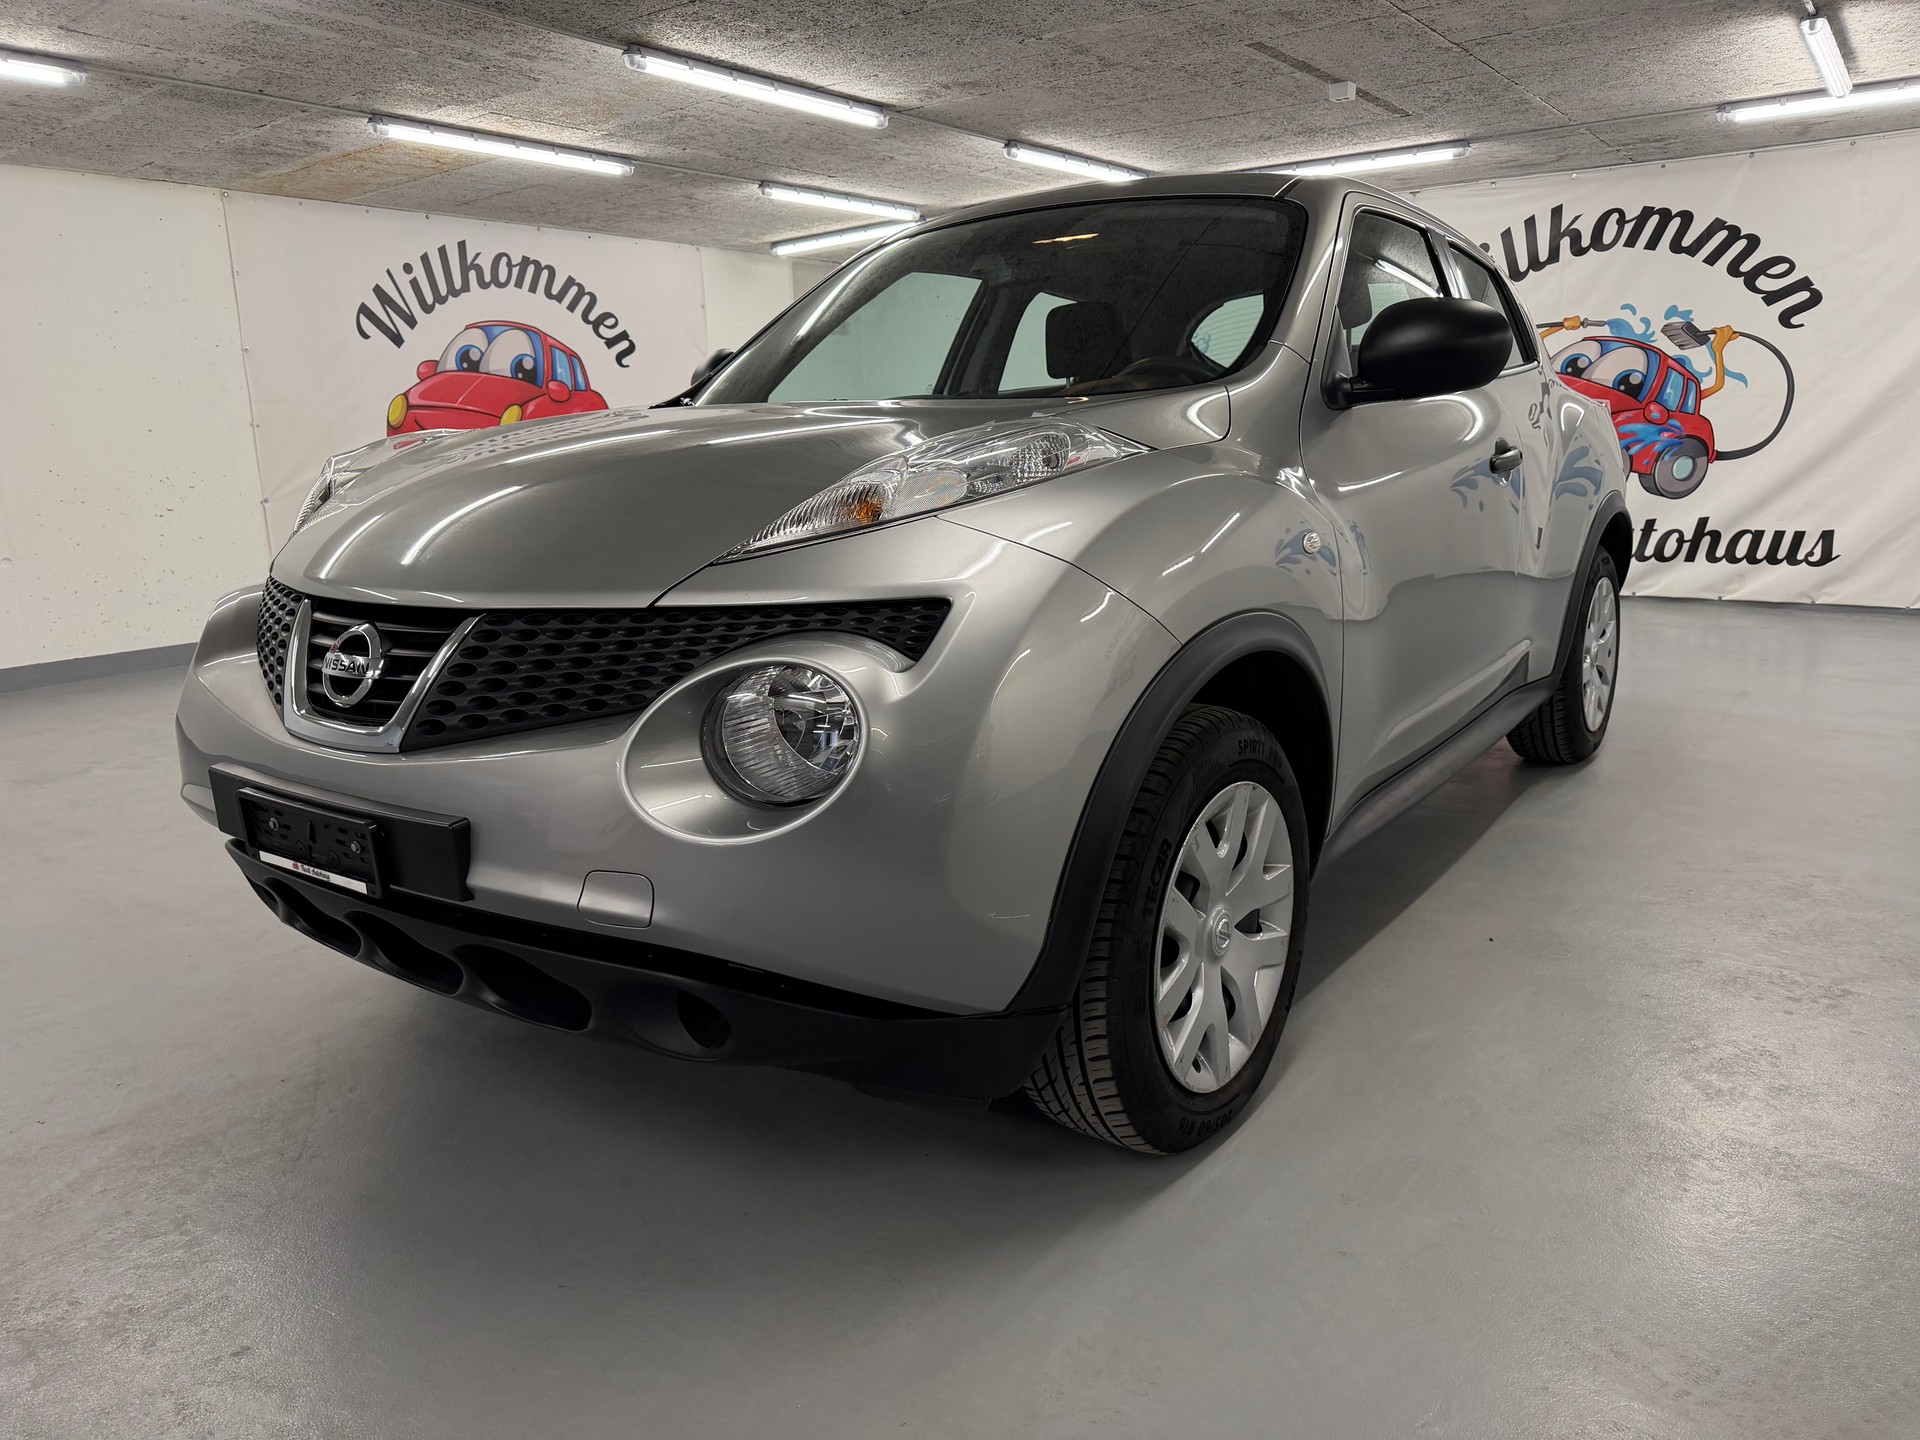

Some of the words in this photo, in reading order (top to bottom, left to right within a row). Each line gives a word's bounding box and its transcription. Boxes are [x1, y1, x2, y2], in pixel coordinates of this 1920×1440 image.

[1479, 203, 1824, 329] llkommen
[355, 239, 637, 368] Willkommen
[1631, 515, 1842, 567] tohaus
[325, 656, 370, 675] NISSAN
[1238, 739, 1266, 756] SPIRIT
